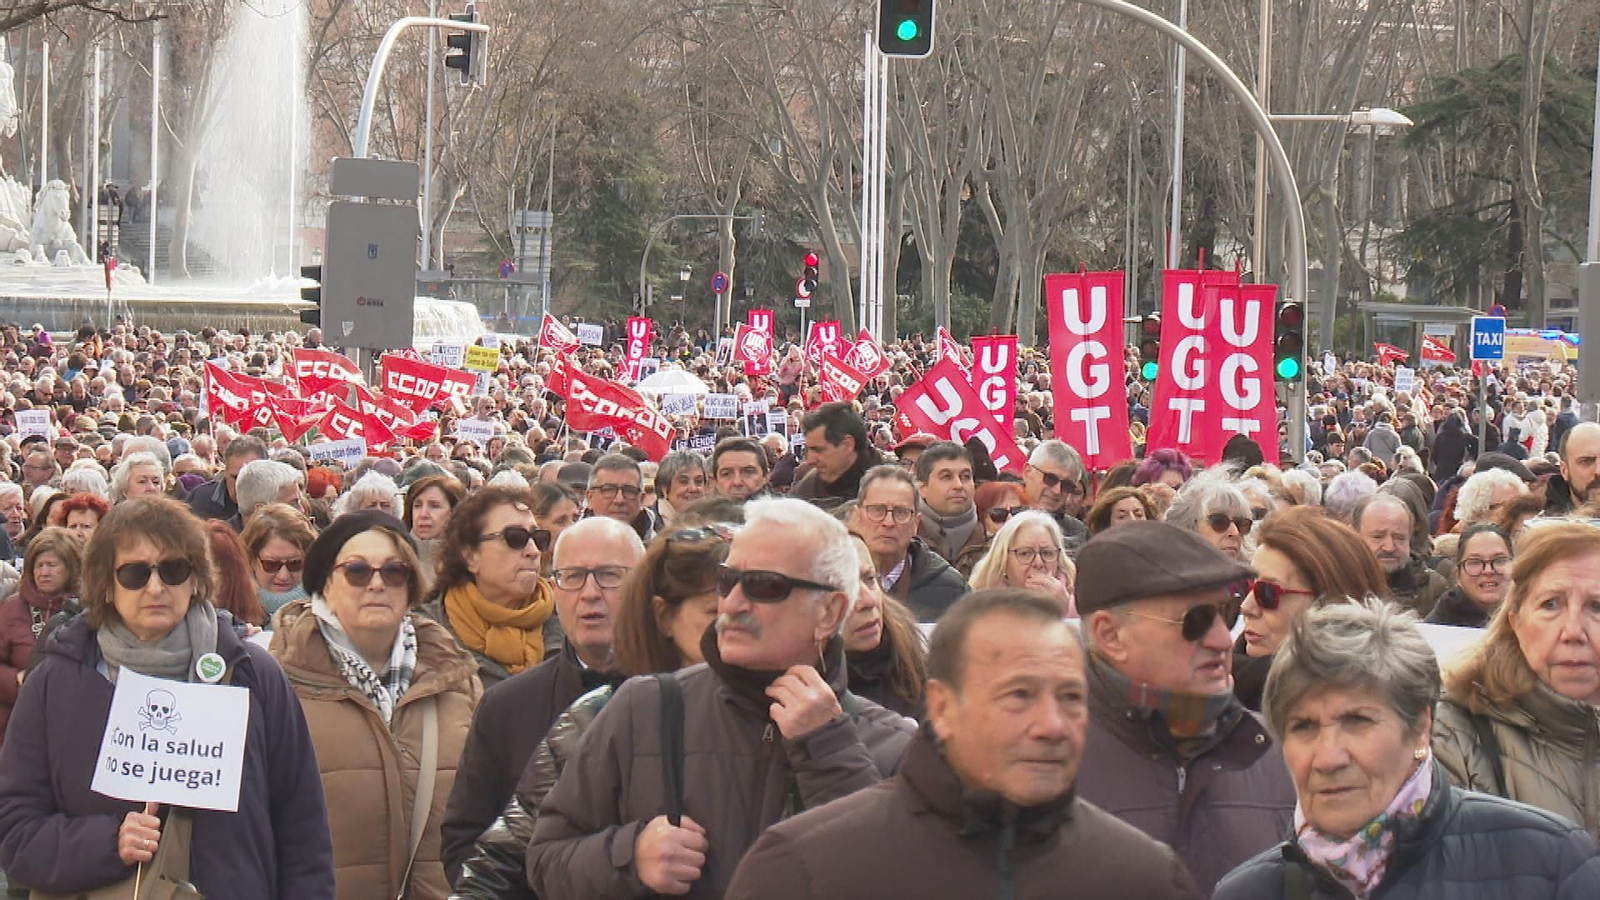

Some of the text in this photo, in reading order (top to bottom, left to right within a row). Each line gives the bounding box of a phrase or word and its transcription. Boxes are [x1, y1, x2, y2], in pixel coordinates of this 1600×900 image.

[1475, 332, 1503, 347] TAXI
[387, 371, 440, 399] CCOO
[980, 345, 1009, 423] UG
[1062, 286, 1111, 456] UGT
[690, 436, 715, 448] VENDE
[141, 733, 159, 752] la
[166, 739, 224, 759] salud
[120, 760, 144, 778] se
[148, 761, 222, 789] juega!
